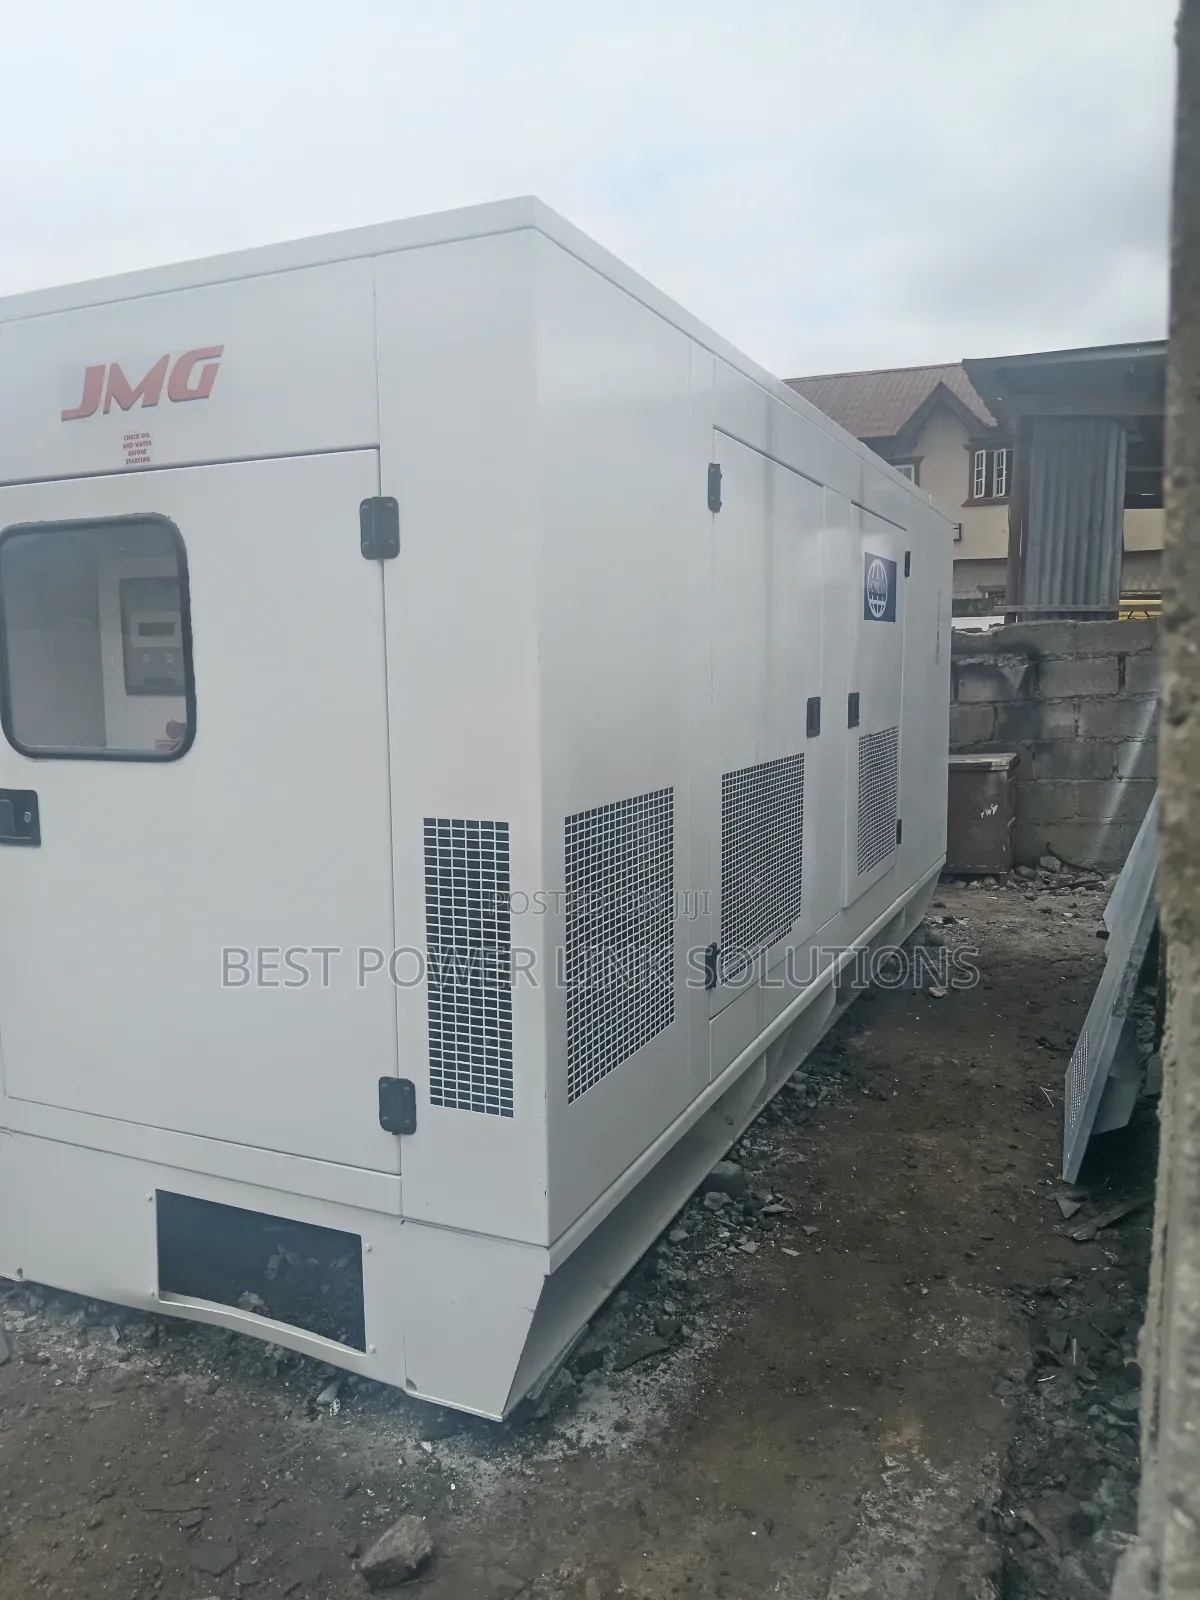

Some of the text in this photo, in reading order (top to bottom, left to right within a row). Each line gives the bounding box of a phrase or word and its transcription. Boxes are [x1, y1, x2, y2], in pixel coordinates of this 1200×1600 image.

[61, 344, 225, 422] JMG
[123, 433, 140, 441] CHECK
[128, 448, 147, 457] BEFORE
